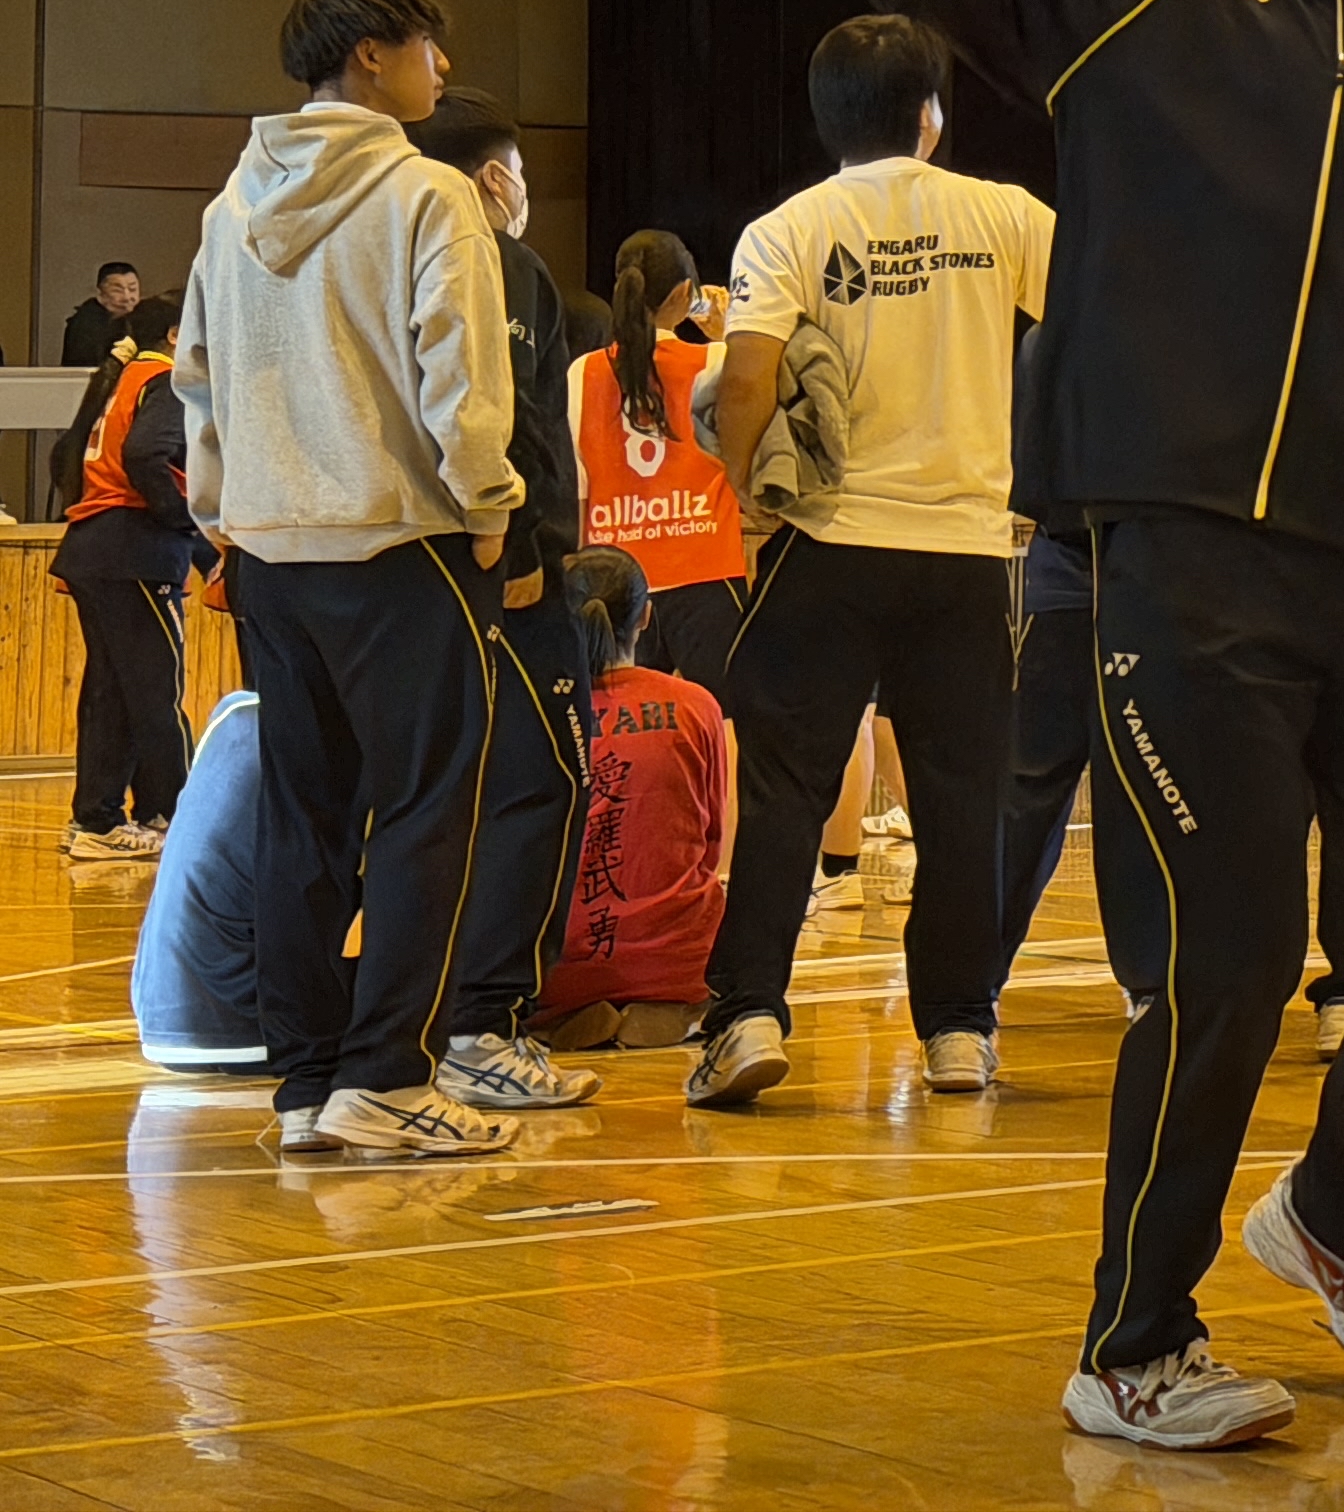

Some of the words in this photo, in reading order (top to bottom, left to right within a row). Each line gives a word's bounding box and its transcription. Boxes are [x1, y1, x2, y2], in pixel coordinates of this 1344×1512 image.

[867, 234, 939, 256] ENGARU
[870, 256, 925, 276] BLACK
[929, 253, 995, 271] STONES
[871, 276, 931, 297] RUGBY
[590, 490, 712, 528] allballz
[665, 519, 718, 536] victory
[566, 703, 592, 788] YAMANOTE
[1122, 698, 1198, 835] YAMANOTE
